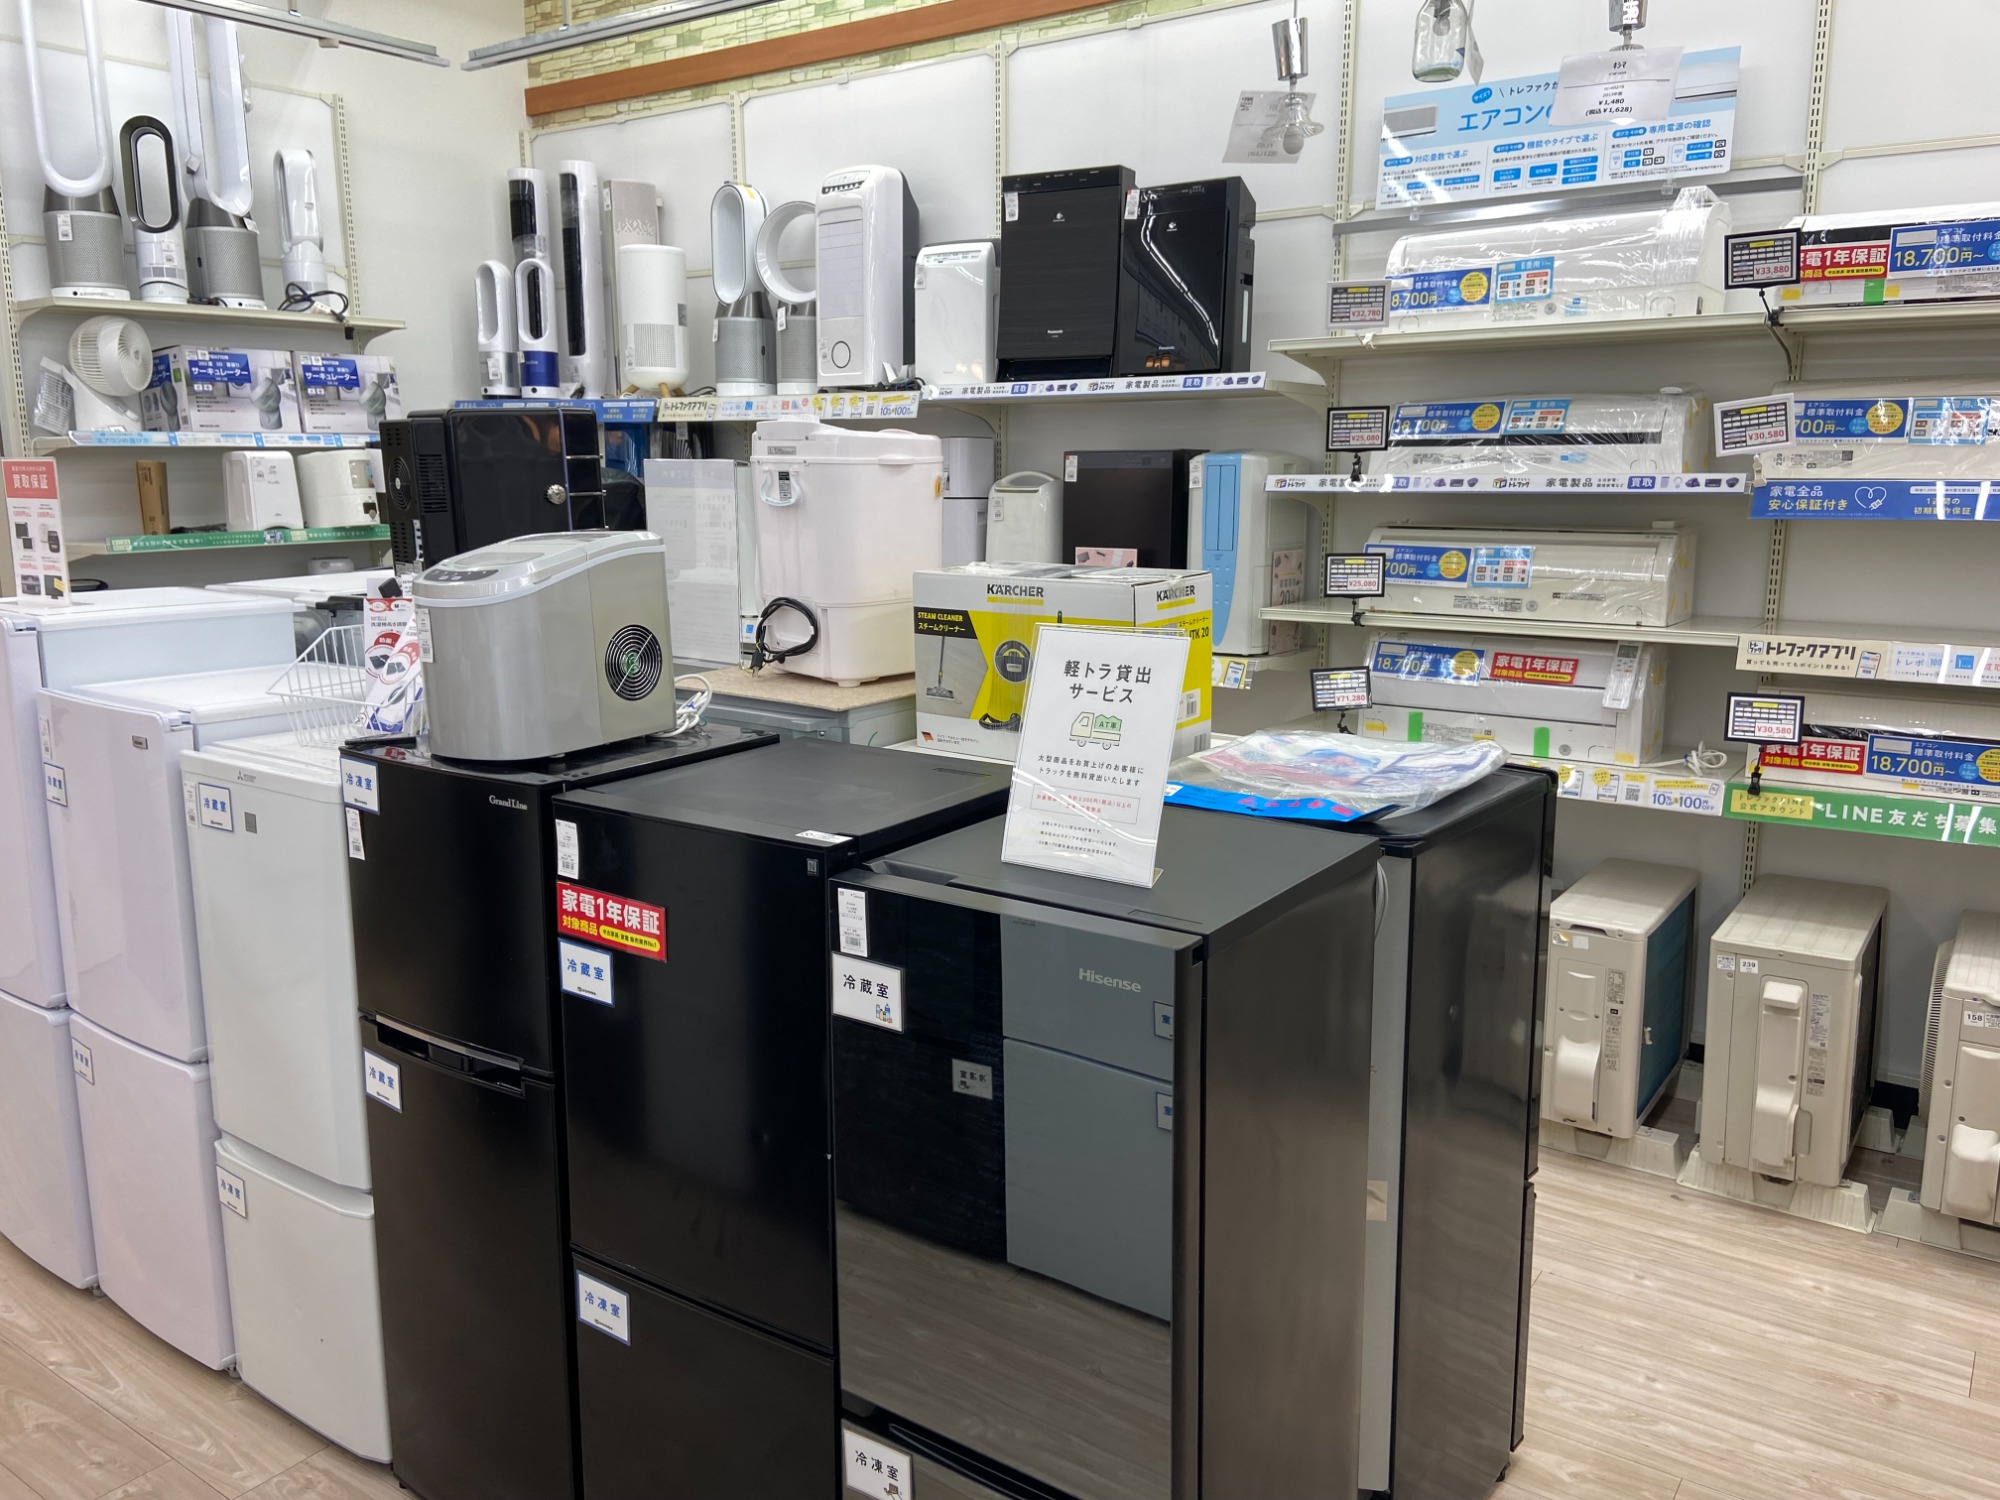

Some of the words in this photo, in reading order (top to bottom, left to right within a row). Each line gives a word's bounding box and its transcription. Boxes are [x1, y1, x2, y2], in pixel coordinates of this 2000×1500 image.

[1598, 98, 1625, 106] ¥1,480
[1457, 104, 1552, 132] エアコン
[1648, 119, 1712, 135] 専用電源の確認
[1527, 133, 1599, 150] 機能やタイプで選ぶ
[1414, 150, 1469, 164] 対応畳数で選ぶ
[1939, 230, 2000, 245] 標準取付料金
[1755, 264, 1790, 276] ¥33,880
[1800, 268, 1823, 278] 商品
[1415, 278, 1459, 290] 標準取付料金
[1391, 291, 1446, 307] 8,700円～
[1351, 309, 1381, 318] ¥32,780
[191, 367, 249, 377] サーキュレーター
[305, 372, 357, 381] サーキュレーター
[1125, 380, 1159, 389] 家電製品
[1184, 378, 1201, 387] 買取
[961, 387, 991, 395] 家電製品
[1012, 385, 1027, 393] 買取
[1427, 409, 1471, 418] 標準取付料金
[1806, 408, 1864, 418] 標準取付料金
[1794, 419, 1846, 435] 700円～
[1351, 433, 1380, 442] ¥25,080
[1748, 430, 1785, 442] ¥30,580
[12, 474, 48, 489] 買取保証
[1546, 478, 1593, 488] 家電製品
[1631, 477, 1653, 487] 買取
[1770, 485, 1823, 497] 家電全品
[1768, 499, 1848, 511] 安心保証付き
[1395, 553, 1438, 562] 標準取付料金
[1385, 561, 1424, 576] 700円～
[1349, 580, 1377, 588] ¥25,080
[986, 583, 1044, 598] KÄRCHER
[917, 611, 937, 621] STEAM
[937, 612, 963, 623] CLEANER
[1178, 615, 1210, 628] スチームクリーナー
[918, 623, 966, 633] スチームクリーナー
[1201, 626, 1210, 638] 20
[1766, 641, 1857, 660] トレファクアプリ
[1495, 655, 1575, 674] 家電1年保証
[1896, 657, 1924, 666] トレポ
[1064, 659, 1152, 684] 軽トラ貸出
[1493, 669, 1523, 677] 対象商品
[1070, 682, 1134, 704] サービス
[1336, 694, 1366, 703] ¥71,280
[1099, 720, 1118, 730] AT車
[1757, 724, 1792, 735] ¥30,580
[1766, 743, 1861, 761] 家電1年保証
[1914, 748, 1974, 761] 標準取付料金
[1038, 755, 1144, 774] 大型商品をお買上げのお客様に
[1764, 756, 1799, 766] 対象商品
[346, 772, 373, 791] 冷凍室
[1039, 767, 1140, 787] トラックを無料貸出いたします
[203, 797, 227, 813] 冷蔵室
[489, 795, 511, 807] Grand
[512, 800, 528, 810] Line
[1652, 793, 1666, 805] 10
[1679, 796, 1702, 809] 100
[1739, 803, 1805, 815] 公式アカウント
[561, 889, 661, 935] 家電1年保証
[561, 914, 598, 936] 対象商品
[566, 958, 604, 982] 冷蔵室
[1742, 960, 1756, 968] 239
[843, 973, 889, 999] 冷蔵室
[1078, 967, 1142, 993] Hisense
[1967, 1013, 1983, 1022] 158
[368, 1065, 395, 1090] 冷蔵室
[584, 1289, 621, 1319] 冷凍室
[855, 1450, 899, 1482] 冷凍室
